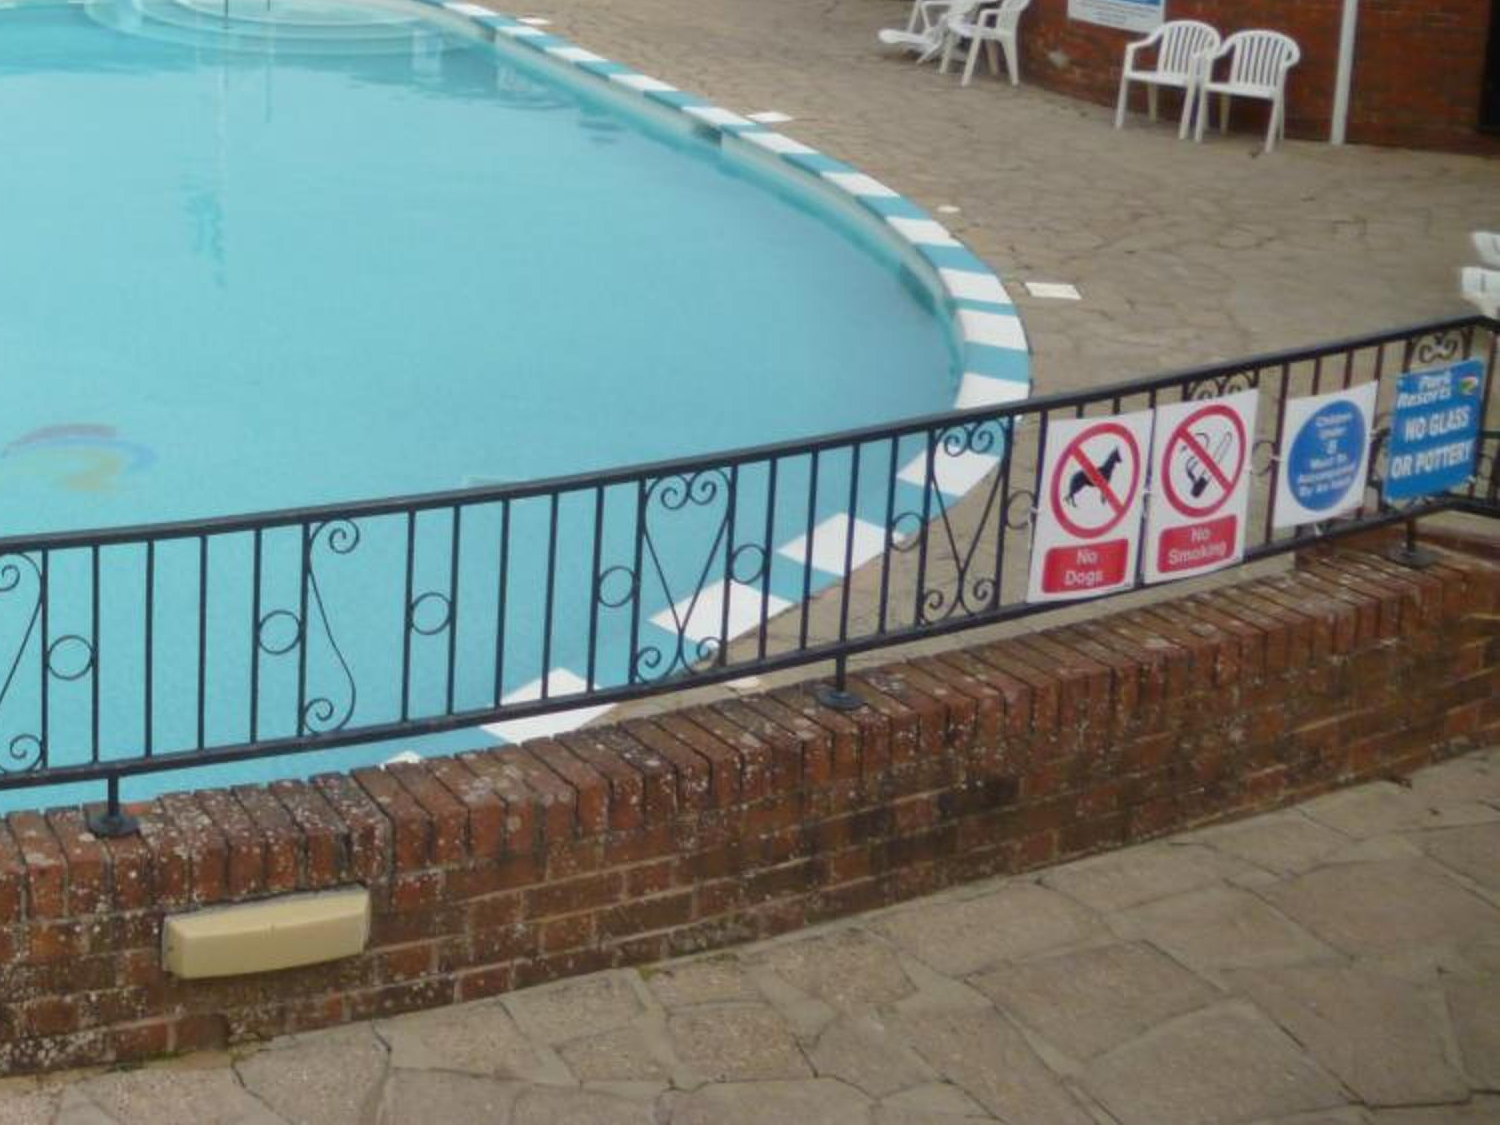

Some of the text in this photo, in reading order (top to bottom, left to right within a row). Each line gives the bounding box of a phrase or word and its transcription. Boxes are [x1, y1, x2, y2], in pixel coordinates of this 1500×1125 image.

[1405, 405, 1471, 443] NO GLASS
[1391, 439, 1475, 481] OR POTTERY
[1167, 530, 1228, 566] Smoking
[1190, 526, 1211, 544] No
[1075, 548, 1098, 565] No
[1063, 570, 1105, 588] Dogs
